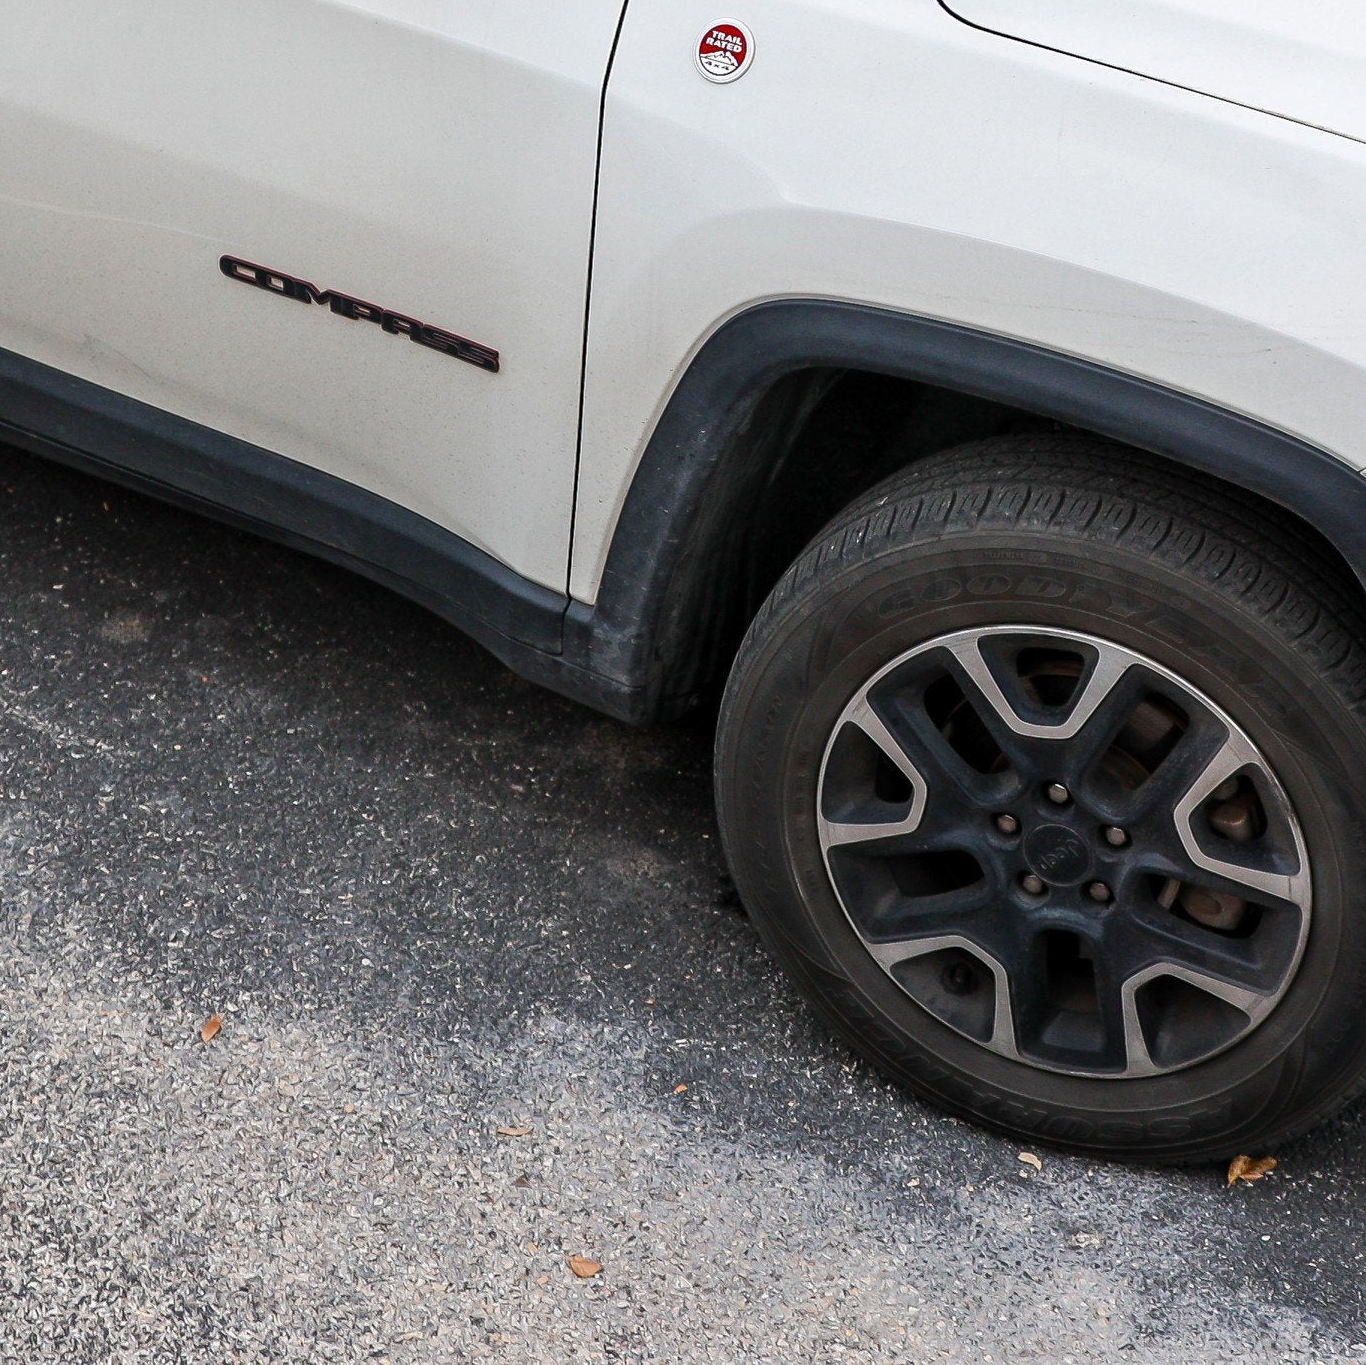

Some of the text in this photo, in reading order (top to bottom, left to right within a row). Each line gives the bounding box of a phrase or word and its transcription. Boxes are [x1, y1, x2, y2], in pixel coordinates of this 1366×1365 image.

[706, 37, 742, 53] RATED
[713, 31, 742, 45] TRAIL
[219, 254, 499, 373] COMPASS
